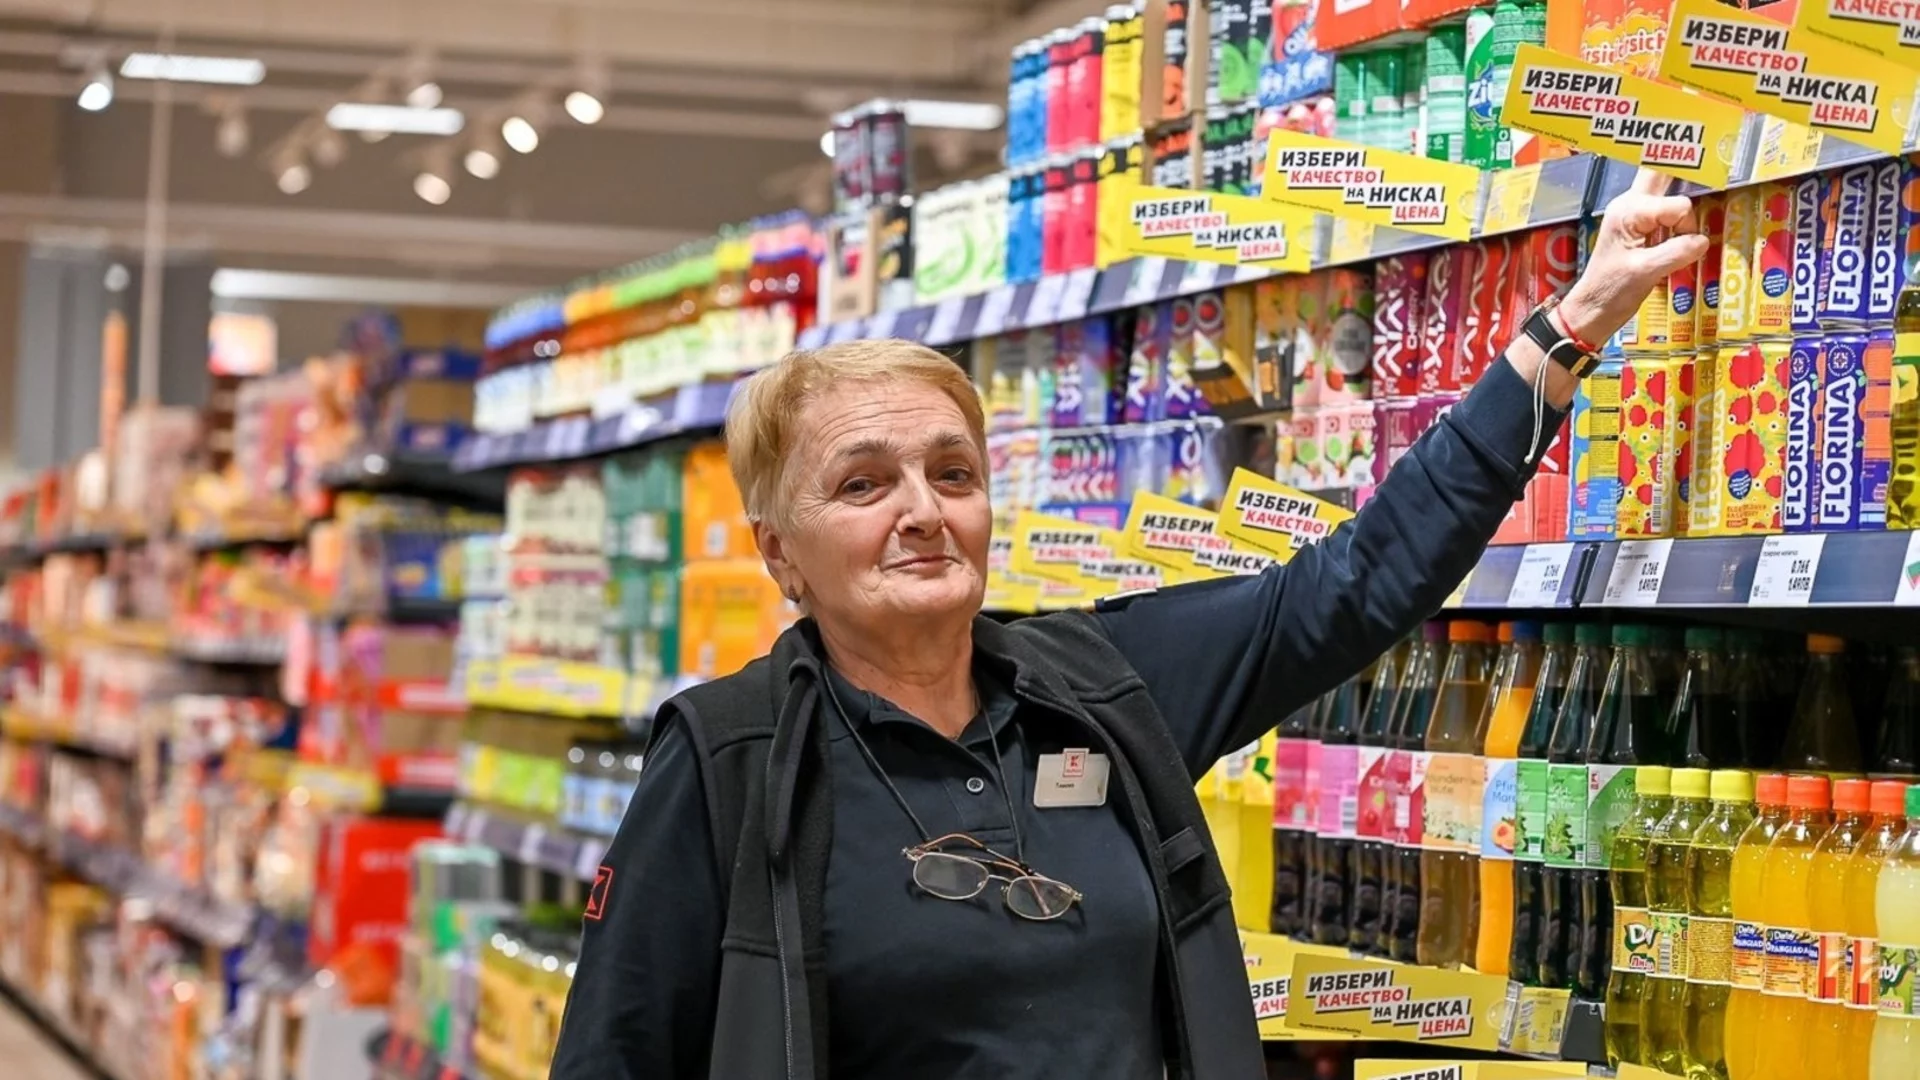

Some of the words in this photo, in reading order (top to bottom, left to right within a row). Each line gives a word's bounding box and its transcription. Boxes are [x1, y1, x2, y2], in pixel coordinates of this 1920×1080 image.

[1686, 19, 1781, 49] ИЗБЕРИ
[1695, 45, 1799, 72] КАЧЕСТВО
[1525, 69, 1614, 94] ИЗБЕРИ
[1760, 75, 1781, 88] НА
[1785, 77, 1867, 103] НИСКА
[1534, 92, 1630, 115] КАЧЕСТВО
[1814, 103, 1869, 124] ЦЕНА
[1594, 118, 1615, 131] НА
[1619, 119, 1694, 143] НИСКА
[1281, 151, 1360, 167] ИЗБЕРИ
[1645, 143, 1696, 161] ЦЕНА
[1290, 170, 1377, 183] КАЧЕСТВО
[1346, 187, 1365, 198] НА
[1369, 187, 1437, 203] НИСКА
[1135, 199, 1206, 219] ИЗБЕРИ
[1395, 205, 1440, 220] ЦЕНА
[1144, 215, 1223, 234] КАЧЕСТВО
[1196, 232, 1212, 242] НА
[1216, 225, 1278, 244] НИСКА
[1830, 170, 1870, 311] FLORINA
[1871, 168, 1897, 307] FLORINA
[1241, 243, 1282, 258] ЦЕНА
[1793, 181, 1816, 318] FLORINA
[1786, 384, 1806, 520] FLORINA
[1824, 376, 1851, 518] FLORINA
[1239, 490, 1312, 517] ИЗБЕРИ
[1142, 514, 1214, 533] ИЗБЕРИ
[1245, 510, 1325, 535] КАЧЕСТВО
[1030, 532, 1094, 545] ИЗБЕРИ
[1149, 531, 1228, 549] КАЧЕСТВО
[1251, 979, 1291, 999] ЗБЕ
[1308, 970, 1387, 993] ИЗБЕРИ
[1318, 988, 1405, 1008] КАЧЕСТВО
[1374, 1006, 1392, 1018] НА
[1396, 999, 1464, 1020] НИСКА
[1421, 1017, 1467, 1035] ЦЕНА
